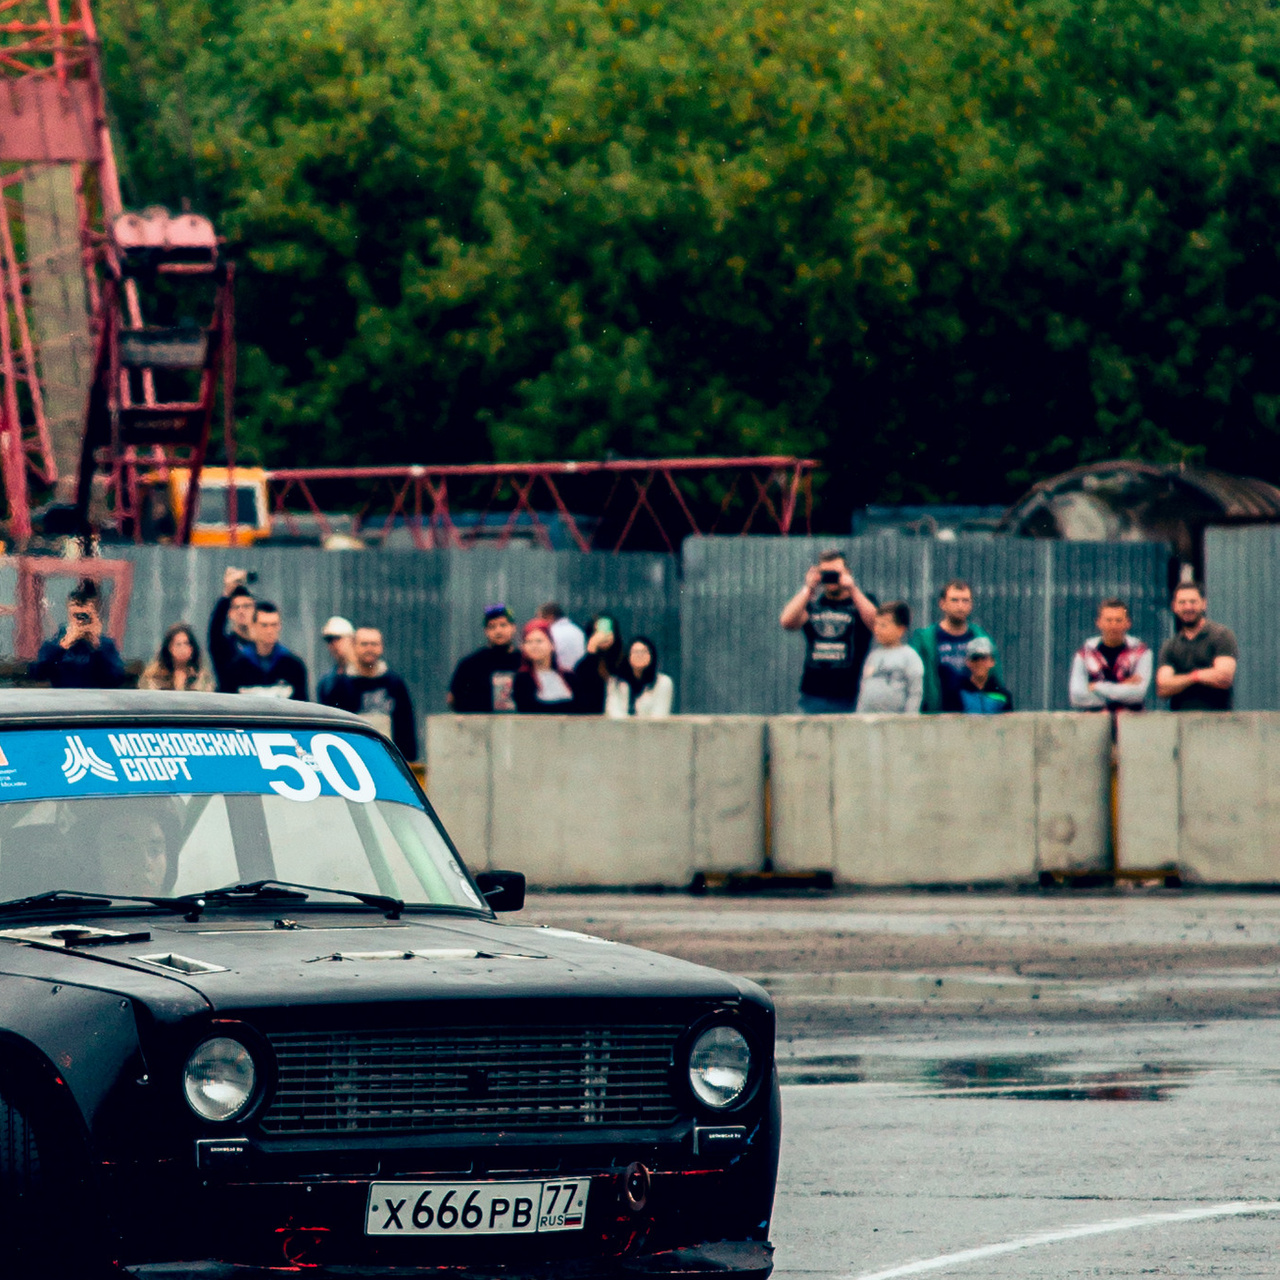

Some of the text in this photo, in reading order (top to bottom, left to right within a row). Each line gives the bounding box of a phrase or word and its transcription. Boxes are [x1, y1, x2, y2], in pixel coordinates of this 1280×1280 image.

[108, 731, 377, 803] МОСКОВСКИЙ 50
[121, 756, 193, 782] СПОРТ
[545, 1183, 579, 1214] 77
[540, 1214, 565, 1227] RUS
